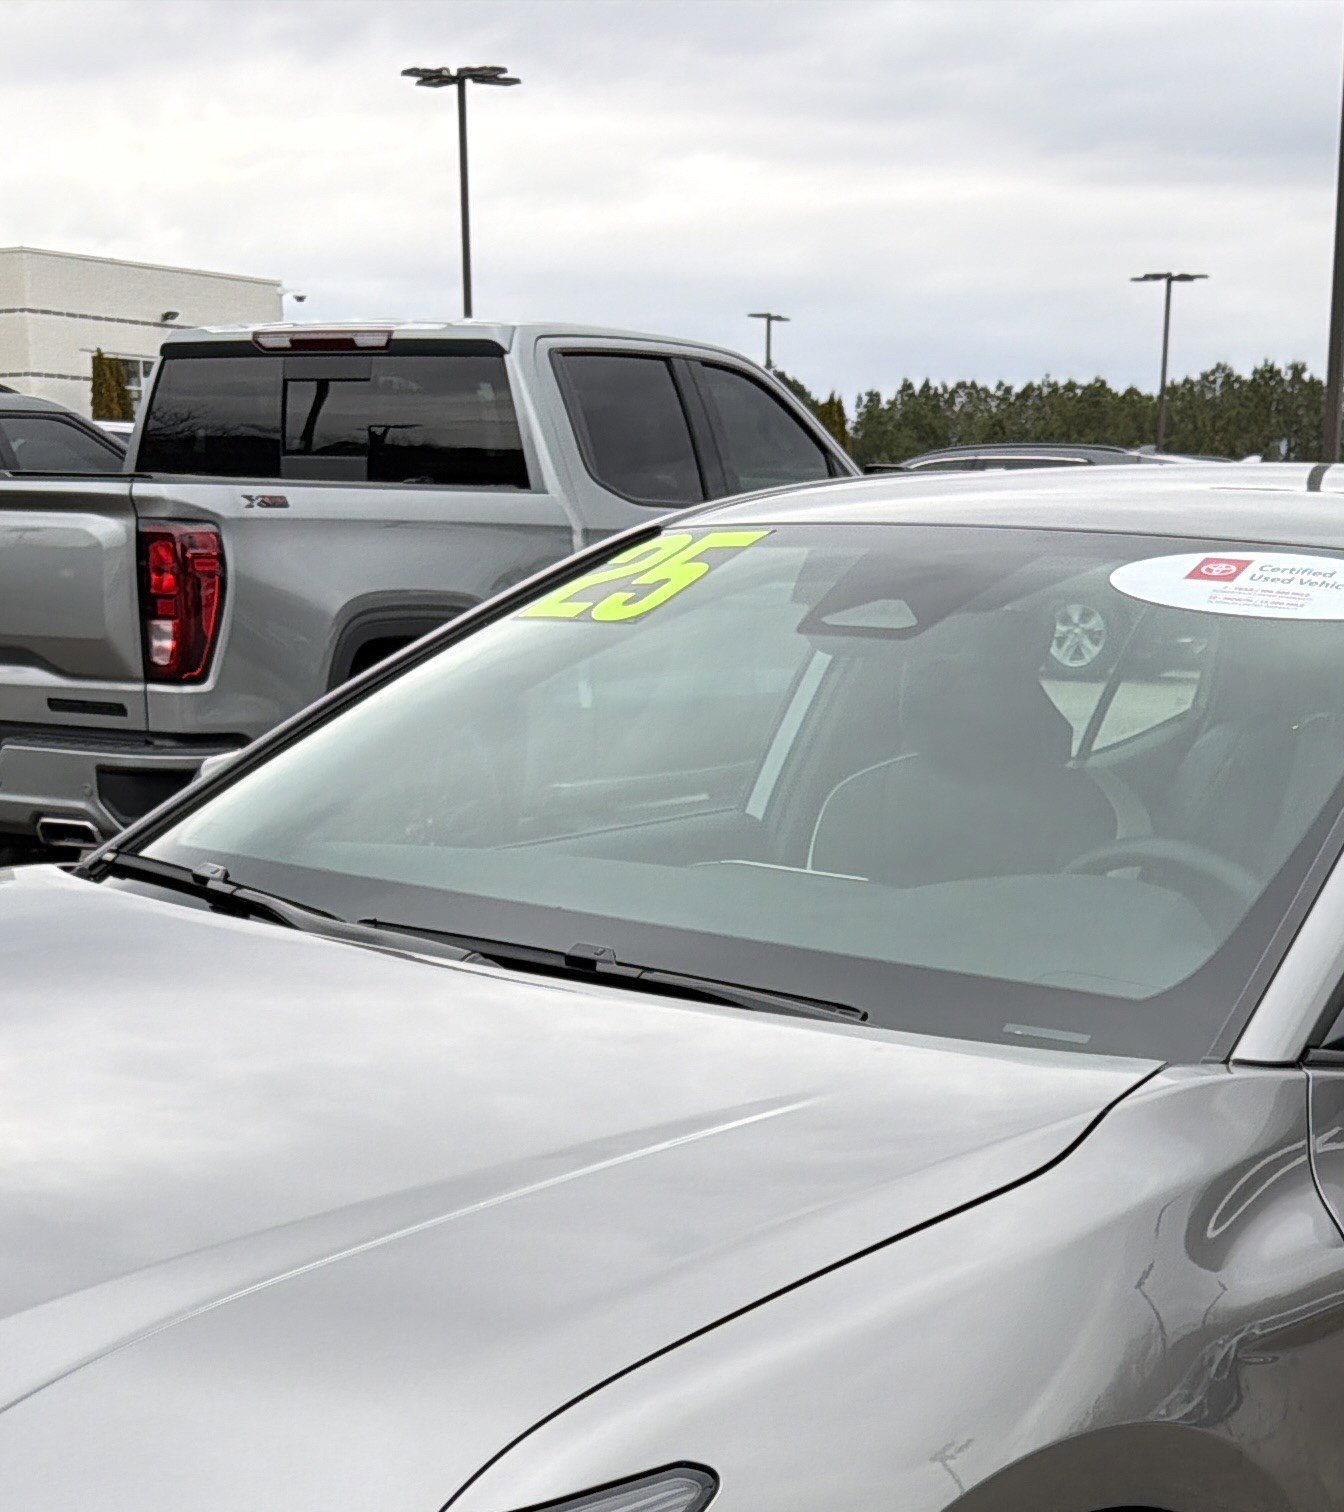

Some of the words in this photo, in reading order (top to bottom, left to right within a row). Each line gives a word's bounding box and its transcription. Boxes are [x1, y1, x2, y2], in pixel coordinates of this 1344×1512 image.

[517, 530, 773, 622] 25
[1249, 573, 1295, 585] Used
[1258, 564, 1337, 579] Certified
